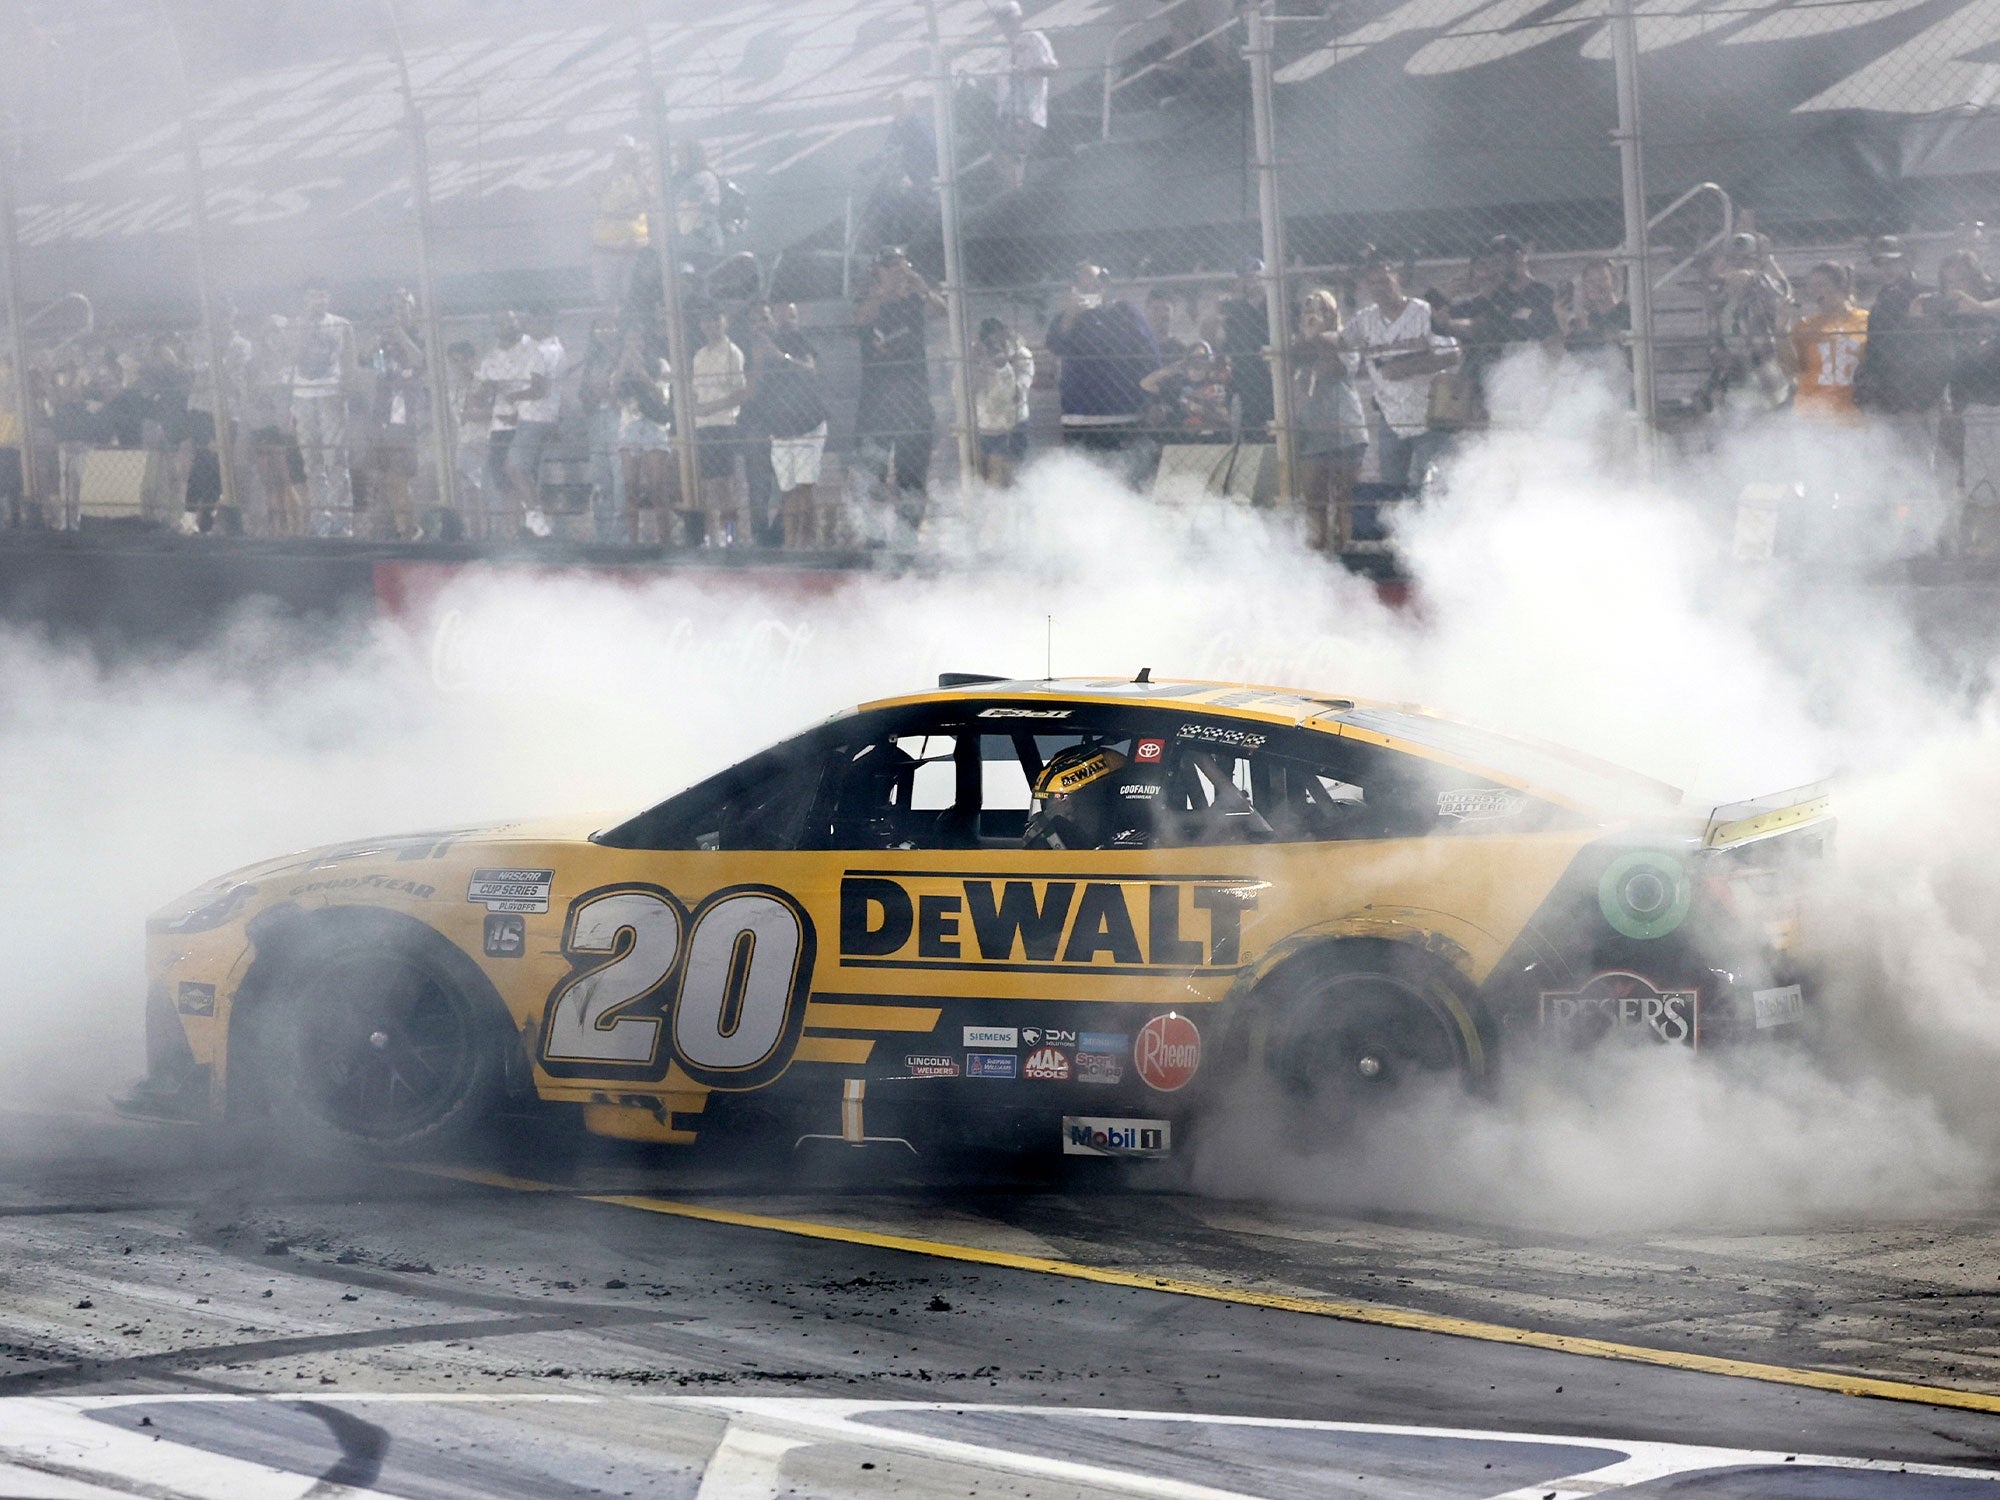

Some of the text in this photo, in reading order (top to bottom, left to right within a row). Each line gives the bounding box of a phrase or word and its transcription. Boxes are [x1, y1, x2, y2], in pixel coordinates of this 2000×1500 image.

[1816, 338, 1860, 386] 16
[1120, 785, 1161, 795] COOFANDY
[497, 871, 541, 881] NASCAR
[480, 884, 539, 896] CUP SERIES
[499, 902, 536, 911] PLAYOFFS
[542, 888, 804, 1074] 20
[969, 1032, 1011, 1042] SIEMENS
[1046, 1029, 1076, 1041] DN
[1143, 1017, 1197, 1078] Rheem
[908, 1056, 950, 1066] LINCOLN
[1026, 1049, 1068, 1070] MAC
[917, 1066, 954, 1075] WELDERS
[1026, 1069, 1068, 1079] TOOLS
[1071, 1125, 1136, 1148] Mobil
